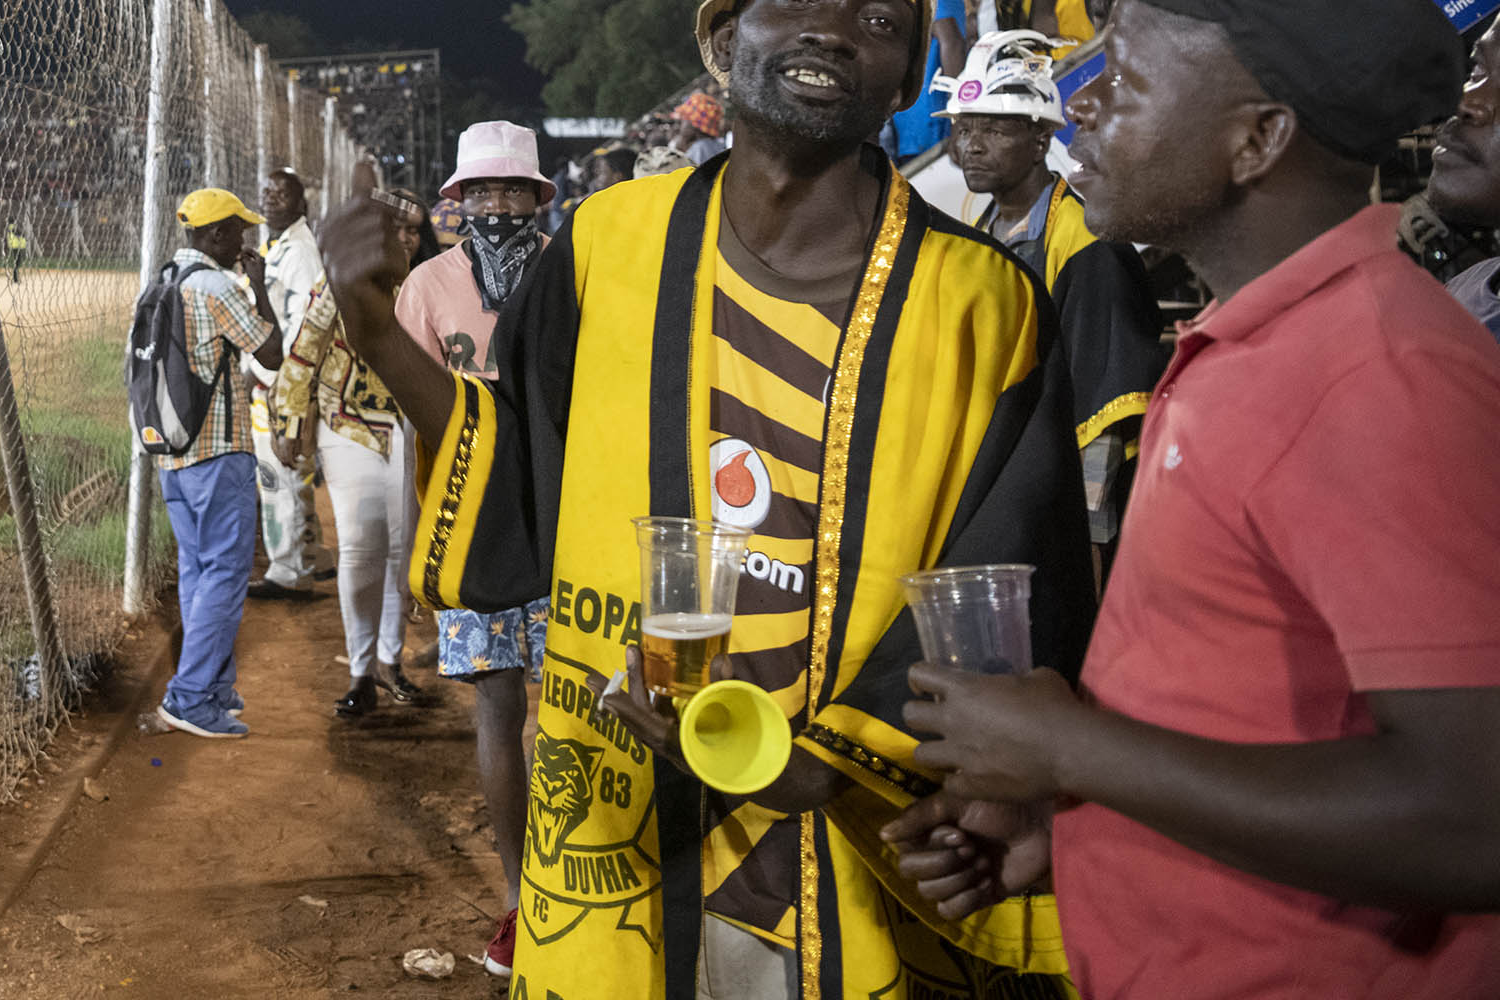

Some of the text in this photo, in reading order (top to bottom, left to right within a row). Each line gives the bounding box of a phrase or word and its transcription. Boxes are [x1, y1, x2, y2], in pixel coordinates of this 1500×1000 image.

[599, 766, 632, 809] 83
[563, 852, 642, 895] DUVHA
[533, 893, 549, 923] FC
